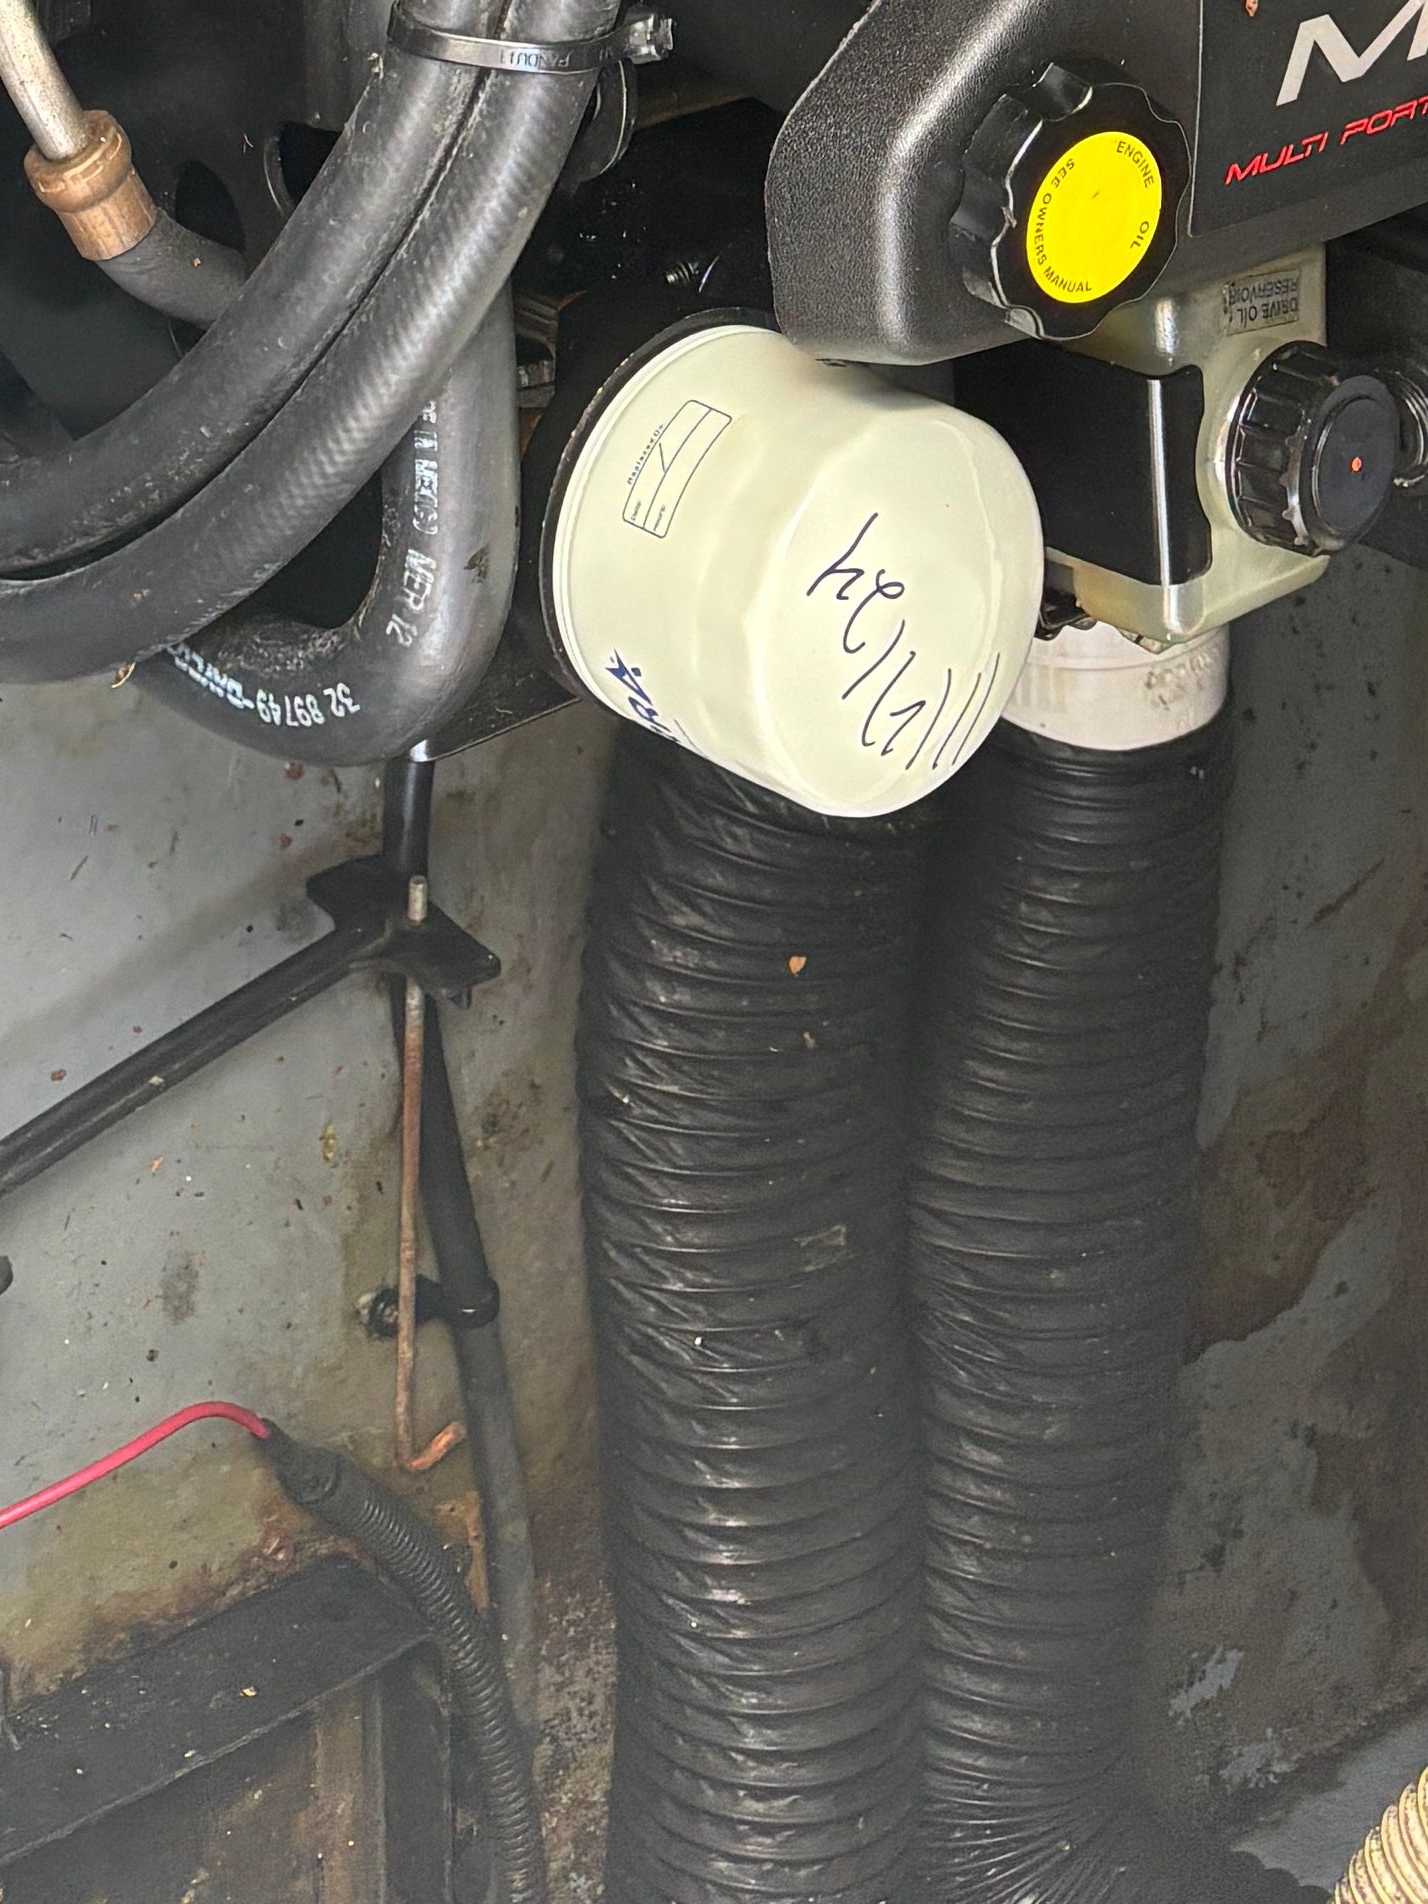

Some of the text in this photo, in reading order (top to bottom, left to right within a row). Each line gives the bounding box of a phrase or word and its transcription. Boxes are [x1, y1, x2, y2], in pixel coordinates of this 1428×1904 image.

[1223, 131, 1328, 186] MULTI
[1114, 138, 1156, 250] ENGINE OIL
[1034, 156, 1093, 295] SEE OWNERS MANUAL
[1228, 278, 1297, 305] RESERVOIR
[1237, 297, 1297, 327] DRIVE OIL
[382, 612, 421, 649] 12
[325, 682, 361, 720] 32
